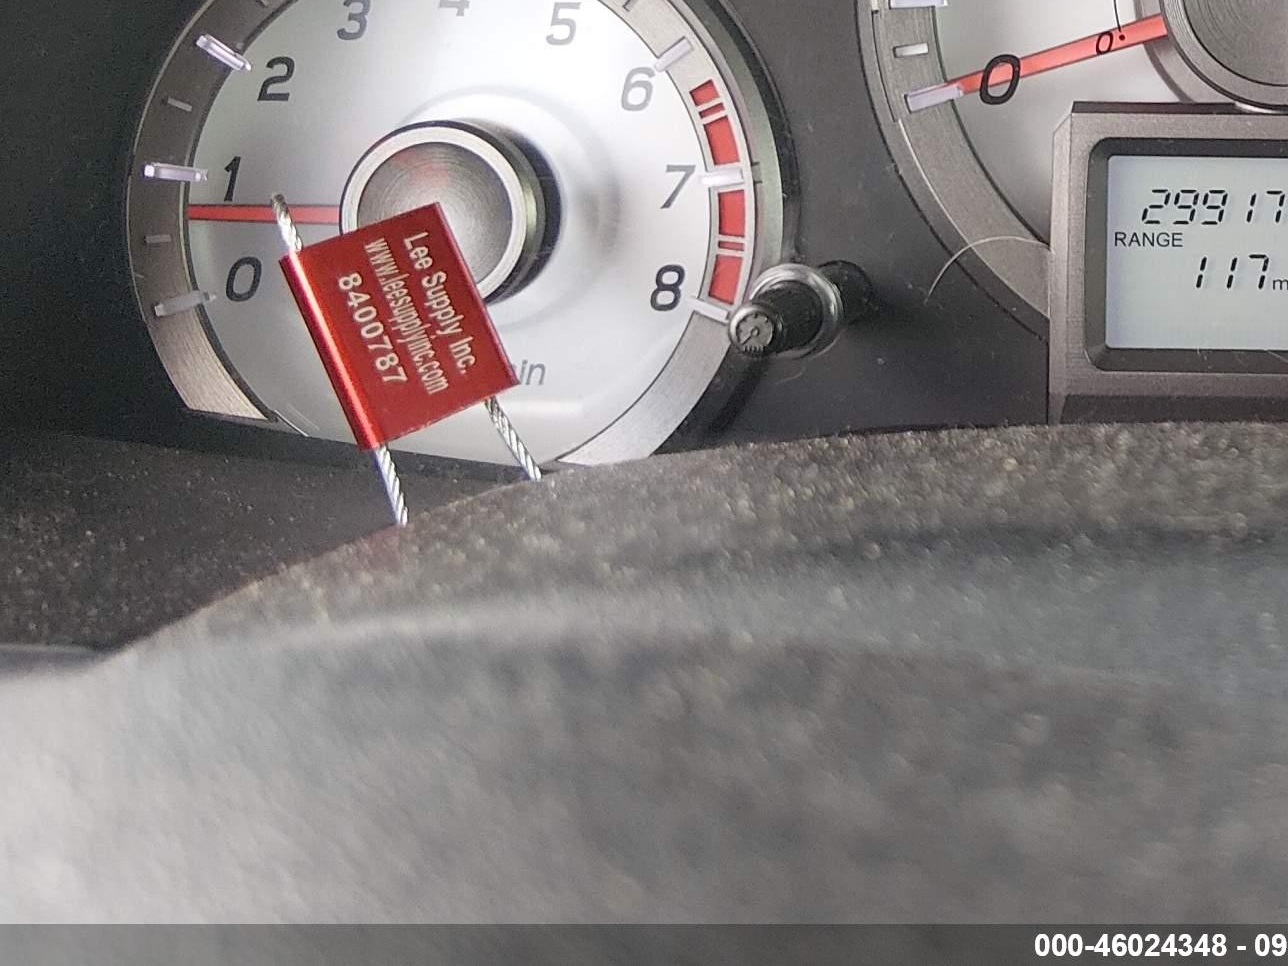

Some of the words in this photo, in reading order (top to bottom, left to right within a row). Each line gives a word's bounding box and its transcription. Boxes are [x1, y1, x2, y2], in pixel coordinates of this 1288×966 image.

[546, 2, 581, 46] 5
[1095, 31, 1114, 55] 0
[257, 56, 295, 102] 2
[620, 65, 655, 111] 6
[979, 54, 1021, 105] 0
[223, 156, 242, 202] 1
[661, 165, 695, 210] 7
[1114, 231, 1183, 248] RANGE
[225, 256, 261, 303] 0
[649, 264, 686, 312] 8
[1195, 254, 1270, 290] 117
[364, 237, 450, 395] www.leesupplyinc.com
[403, 231, 433, 271] Lee
[421, 270, 465, 336] Supply
[450, 336, 477, 376] Inc.
[338, 271, 408, 383] 8400787
